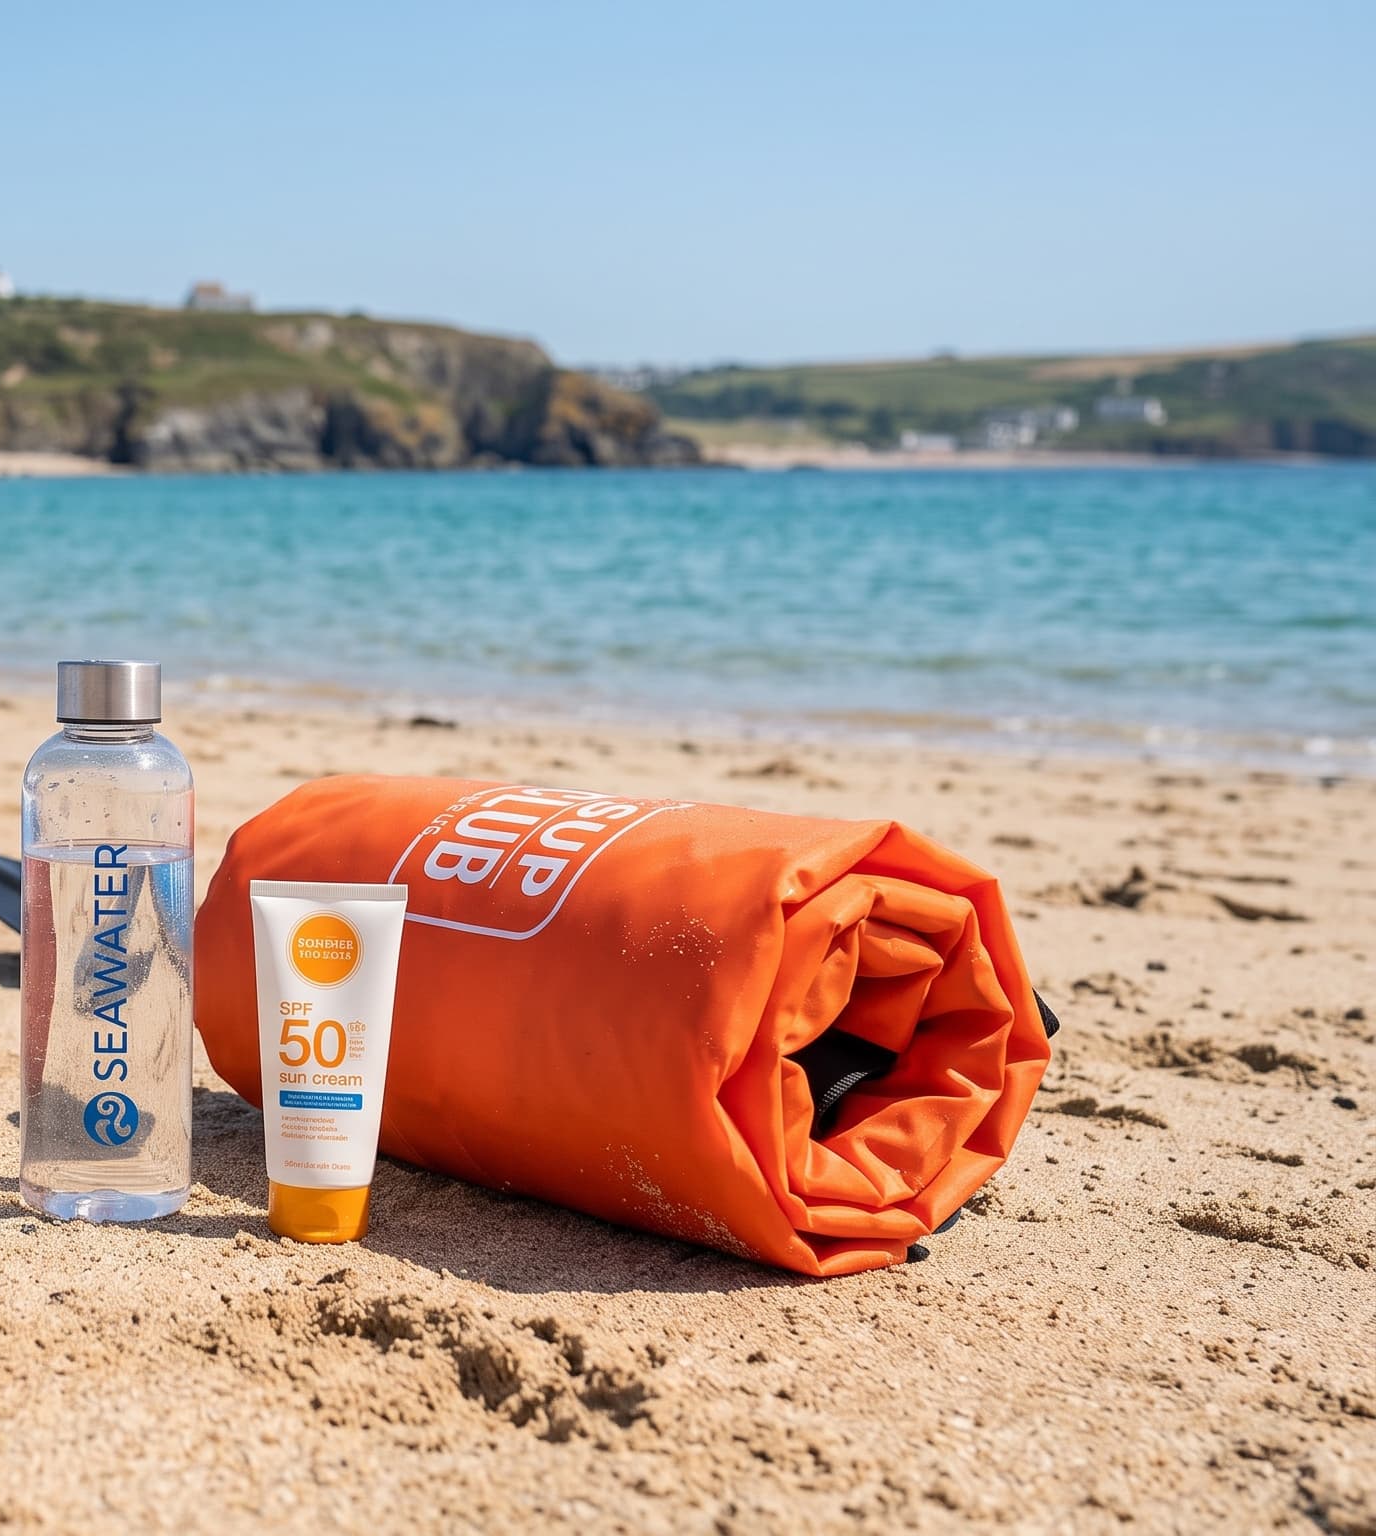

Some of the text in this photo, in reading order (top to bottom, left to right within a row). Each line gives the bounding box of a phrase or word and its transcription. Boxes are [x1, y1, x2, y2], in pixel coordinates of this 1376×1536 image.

[423, 787, 615, 885] CLUB
[518, 800, 639, 897] SUP
[92, 843, 128, 1082] SEAWATER
[278, 1018, 347, 1069] 50
[279, 1001, 313, 1016] SPF
[279, 1072, 363, 1087] sun cream
